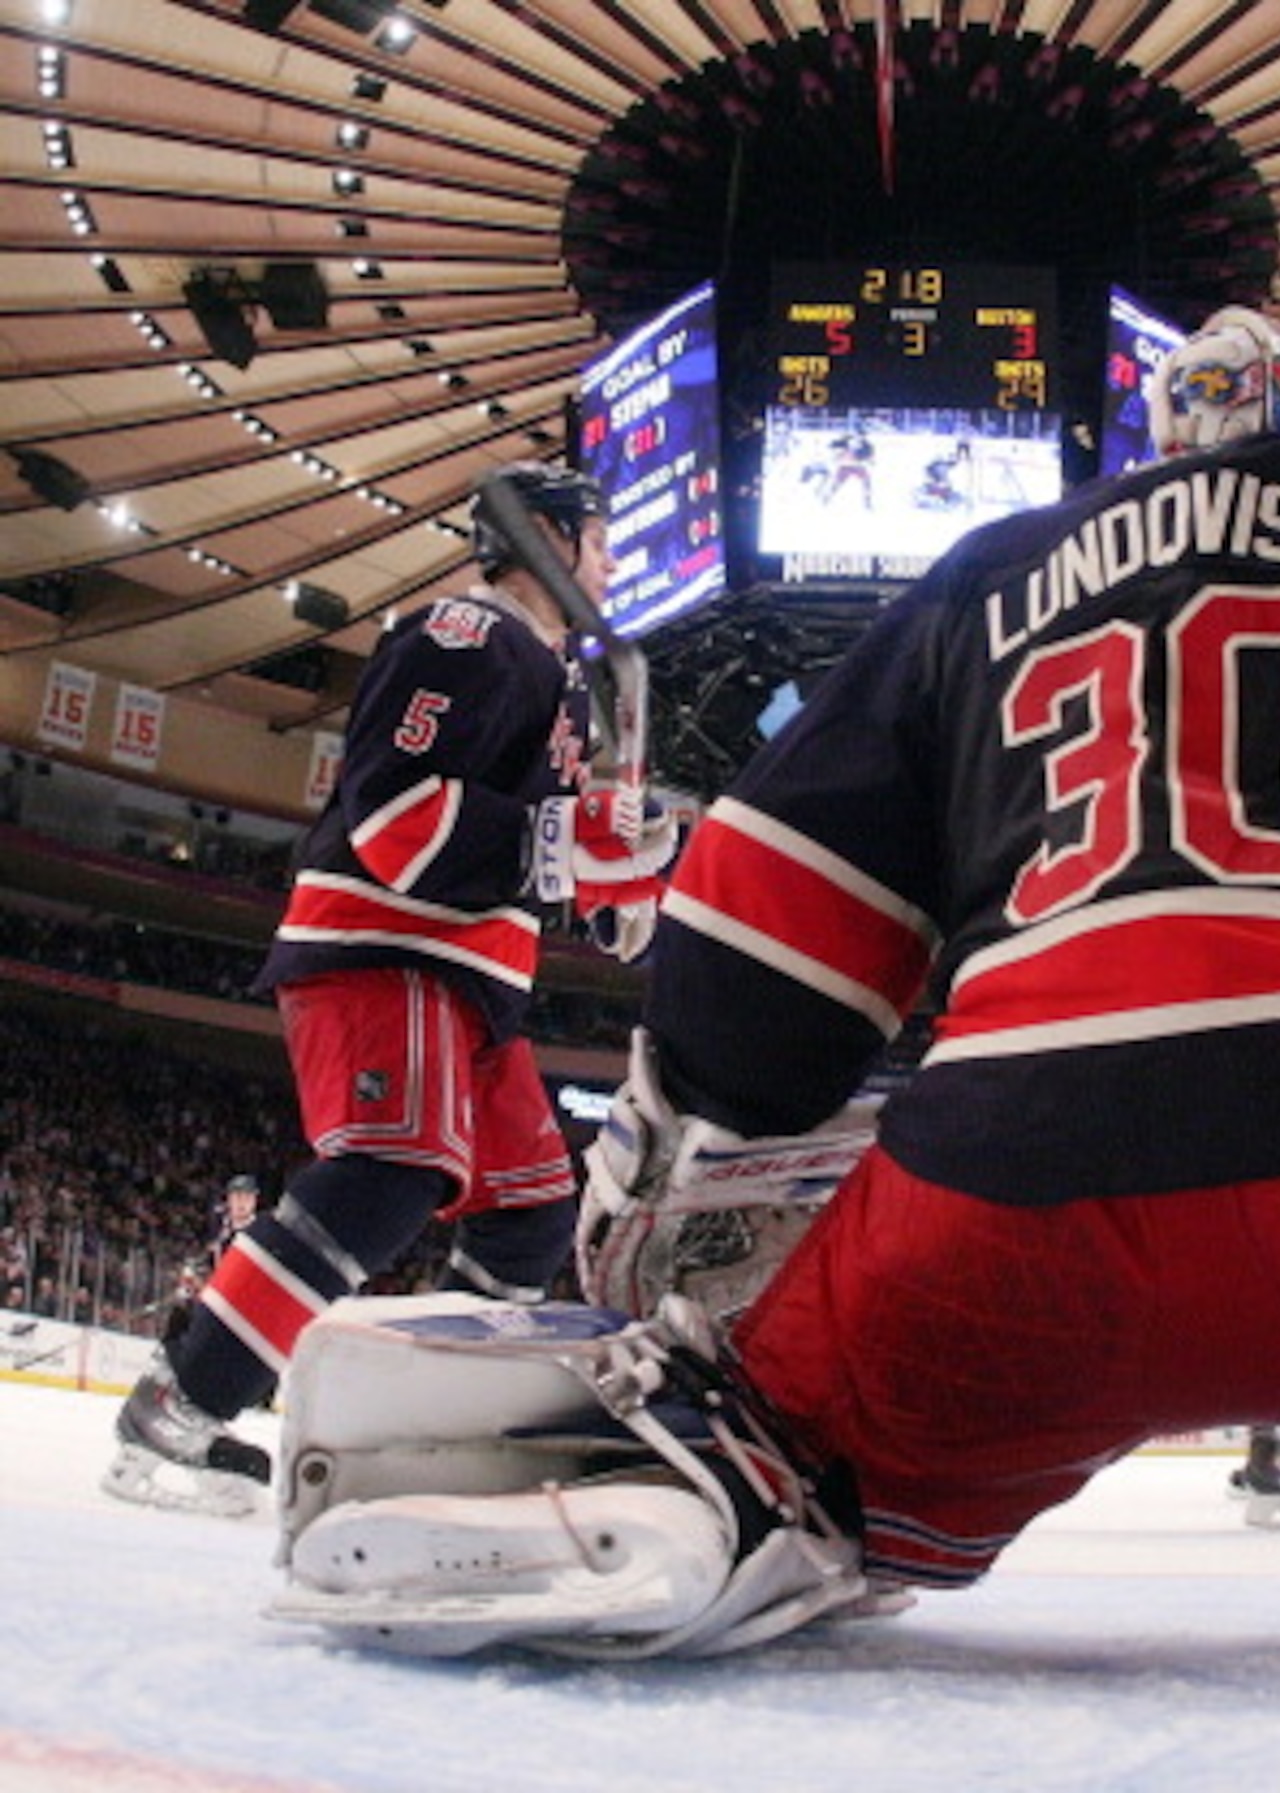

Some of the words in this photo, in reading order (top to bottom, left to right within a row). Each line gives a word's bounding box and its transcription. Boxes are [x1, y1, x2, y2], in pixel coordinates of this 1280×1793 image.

[826, 320, 852, 355] 5
[903, 321, 925, 356] 3
[1014, 324, 1036, 359] 3
[779, 374, 829, 406] 26
[395, 688, 450, 754] 5
